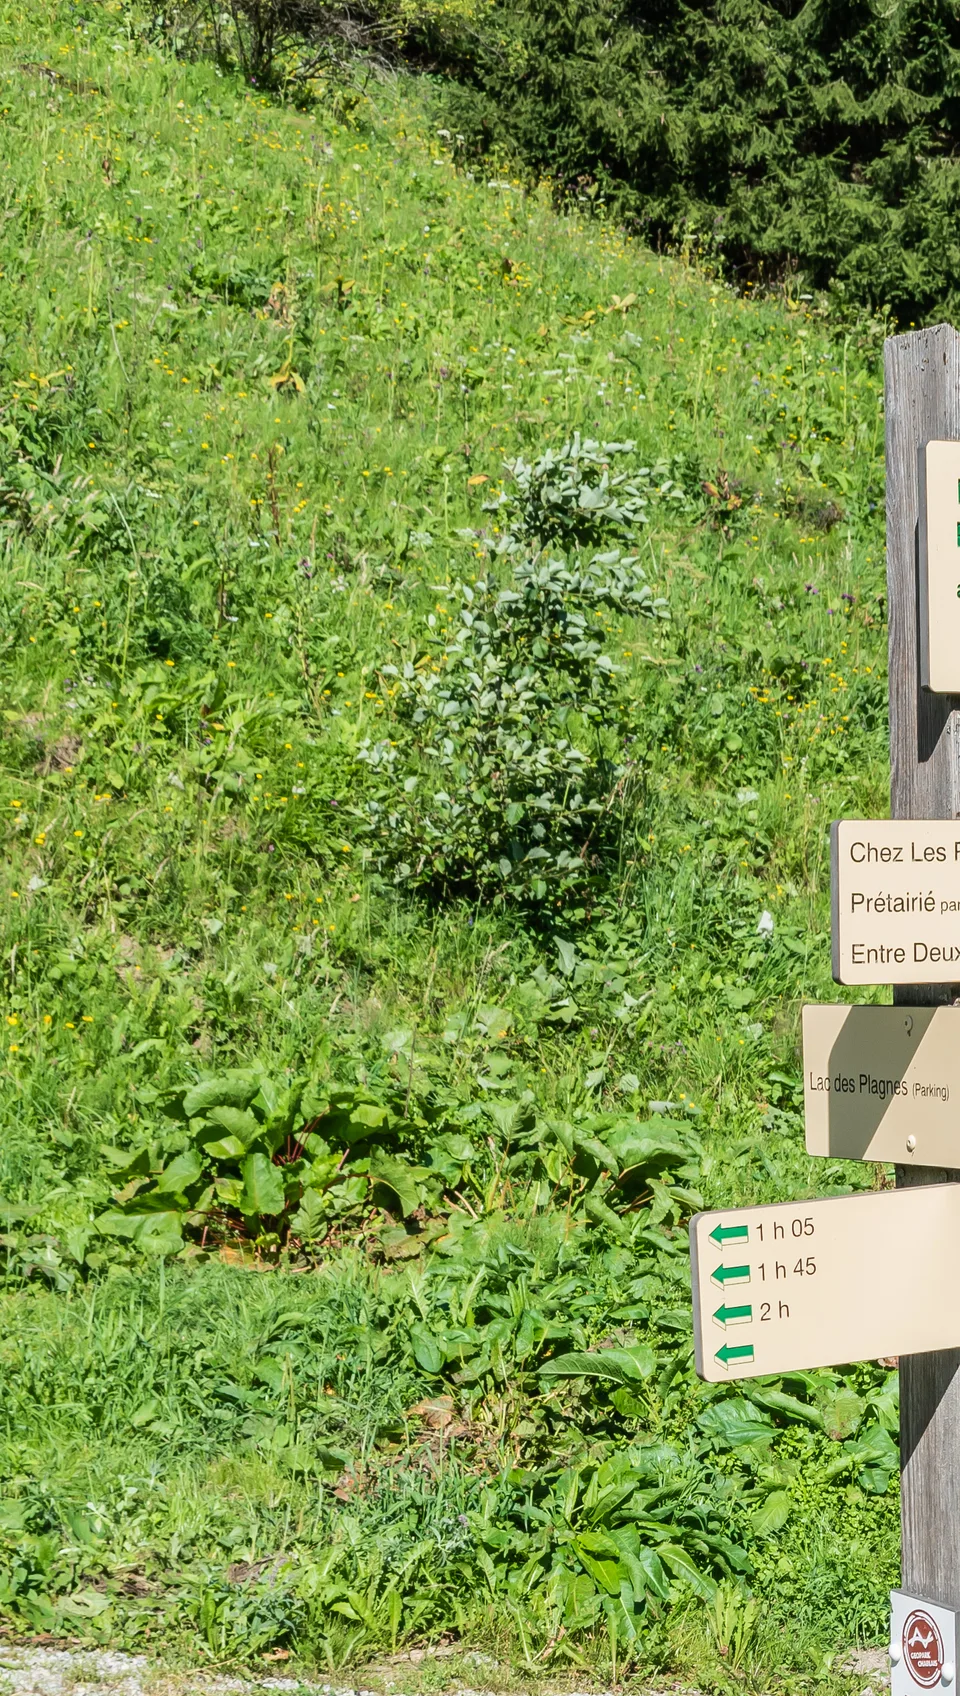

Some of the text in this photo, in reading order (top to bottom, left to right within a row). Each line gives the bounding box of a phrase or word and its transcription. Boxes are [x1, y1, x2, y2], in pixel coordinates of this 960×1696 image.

[850, 841, 904, 863] Chez
[911, 841, 947, 862] Les
[851, 890, 936, 913] Prétairié
[852, 943, 906, 964] Entre
[809, 1072, 950, 1101] Lac des Plagnes (Parking)
[756, 1217, 815, 1242] 1 h 05
[758, 1256, 817, 1281] 1 h 45
[760, 1300, 790, 1321] 2 h
